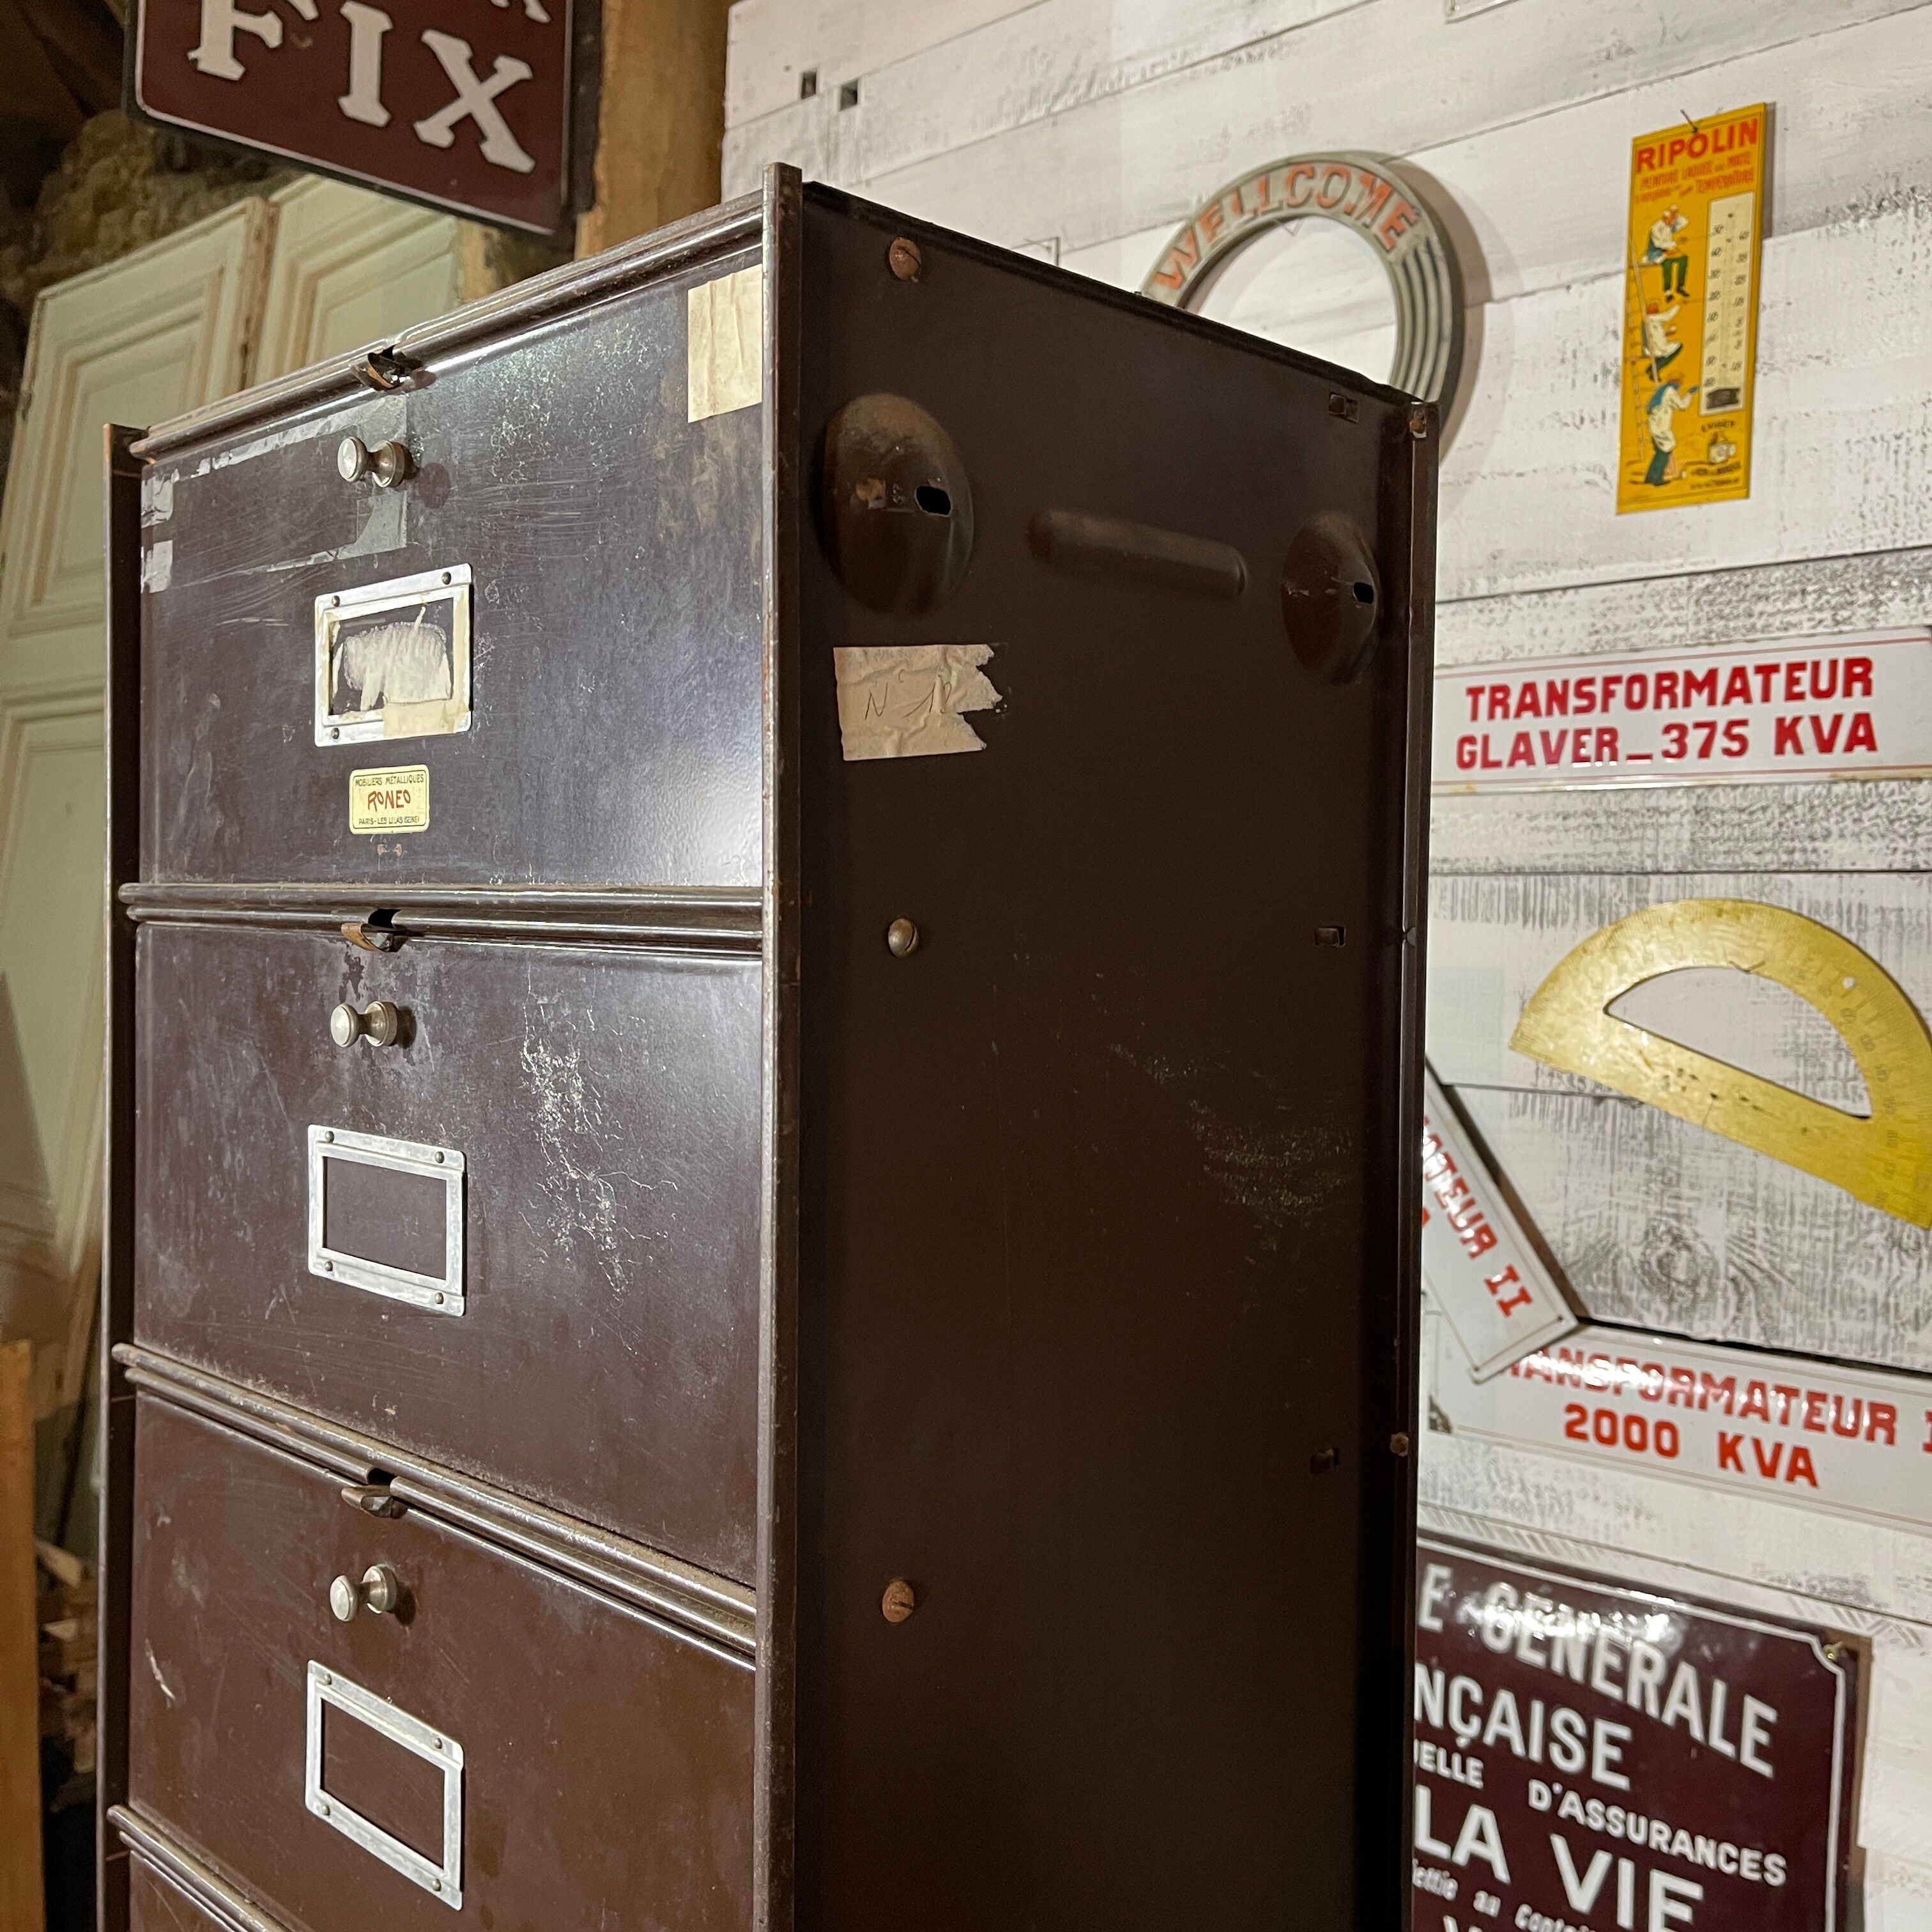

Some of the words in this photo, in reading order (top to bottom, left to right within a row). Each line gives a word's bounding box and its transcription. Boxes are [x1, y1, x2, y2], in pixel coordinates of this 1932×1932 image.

[187, 0, 536, 174] FIX
[1636, 118, 1758, 173] RIPOLIN
[1466, 657, 1874, 721] TRANSFORMATEUR
[1774, 712, 1878, 756] KVA
[355, 777, 383, 786] MOBILIERS
[367, 789, 411, 812] RONEO
[1484, 1264, 1533, 1318] II
[1564, 1402, 1680, 1459] 2000
[1717, 1430, 1819, 1488] KVA
[1414, 1784, 1512, 1885] LA
[1549, 1832, 1705, 1932] VIE
[1528, 1779, 1787, 1887] D'ASSURANCES
